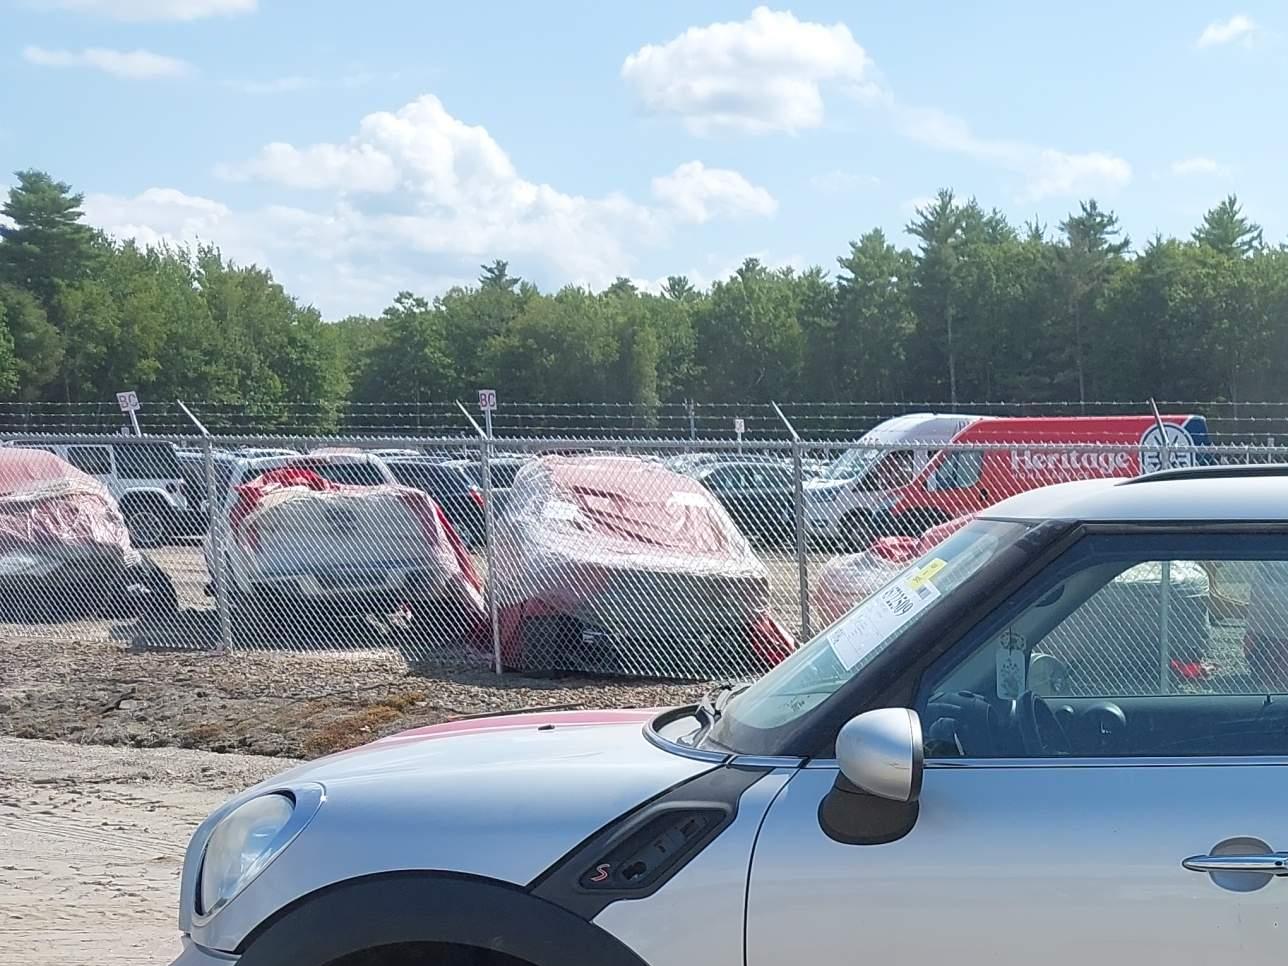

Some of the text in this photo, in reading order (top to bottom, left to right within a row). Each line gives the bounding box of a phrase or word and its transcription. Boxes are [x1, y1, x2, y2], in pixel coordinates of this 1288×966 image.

[480, 392, 496, 407] BC
[1010, 449, 1130, 475] Heritage
[590, 863, 611, 882] S
